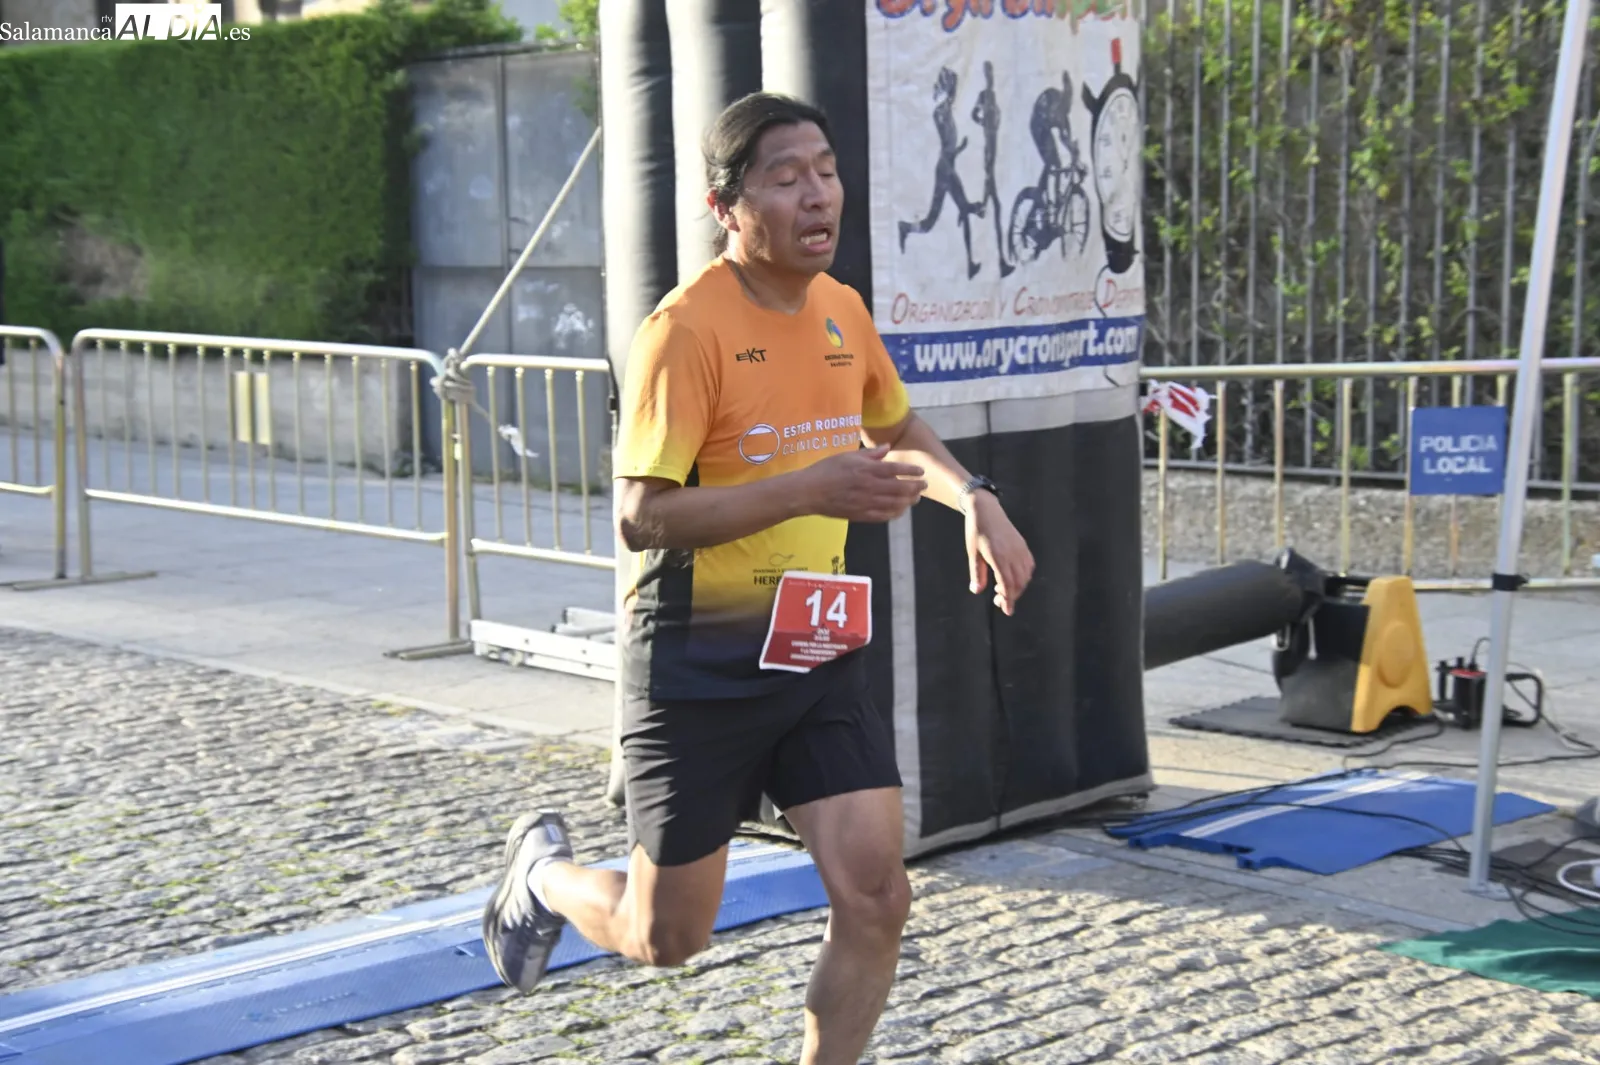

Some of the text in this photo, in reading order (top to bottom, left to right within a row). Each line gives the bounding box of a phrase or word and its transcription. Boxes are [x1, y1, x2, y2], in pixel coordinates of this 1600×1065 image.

[736, 348, 767, 364] EKT
[783, 421, 812, 438] ESTER
[1419, 434, 1498, 453] POLICIA
[1423, 456, 1494, 474] LOCAL
[805, 588, 848, 628] 14
